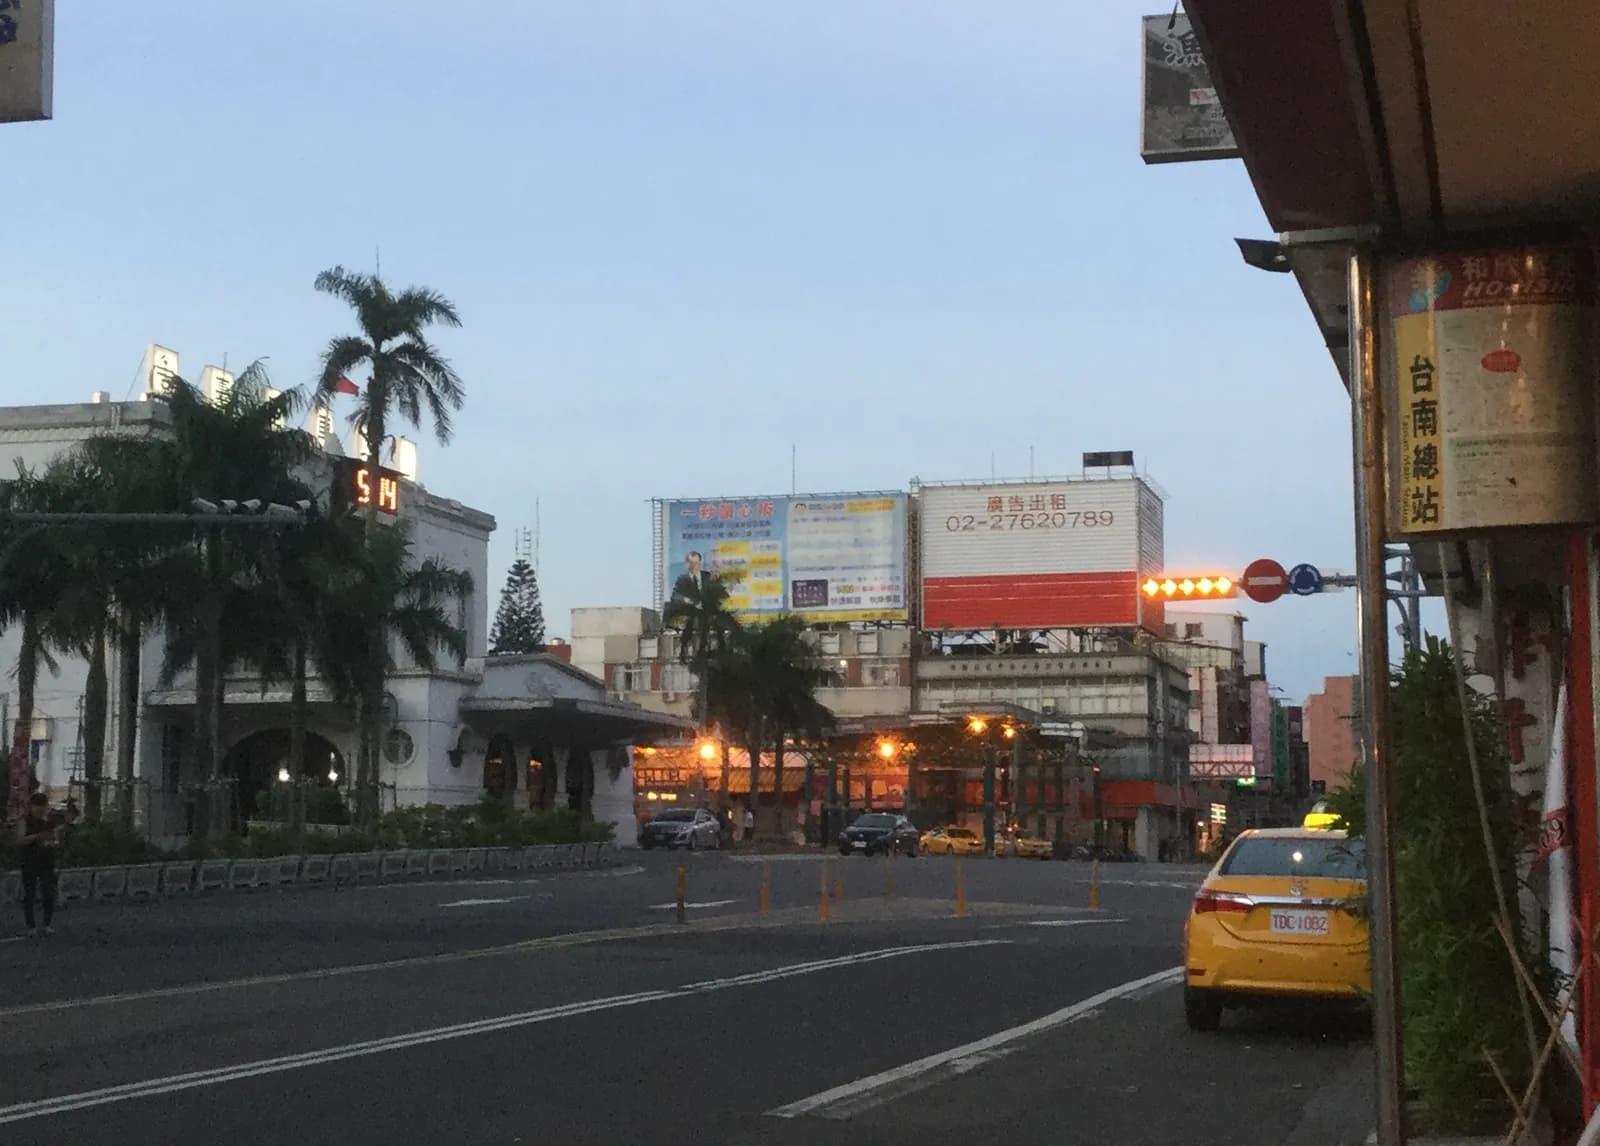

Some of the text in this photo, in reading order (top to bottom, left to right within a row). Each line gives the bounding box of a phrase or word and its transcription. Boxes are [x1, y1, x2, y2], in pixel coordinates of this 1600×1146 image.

[1410, 354, 1438, 524] 台南總站
[986, 494, 1066, 512] 廣告出租
[945, 510, 1113, 532] 02-27620789
